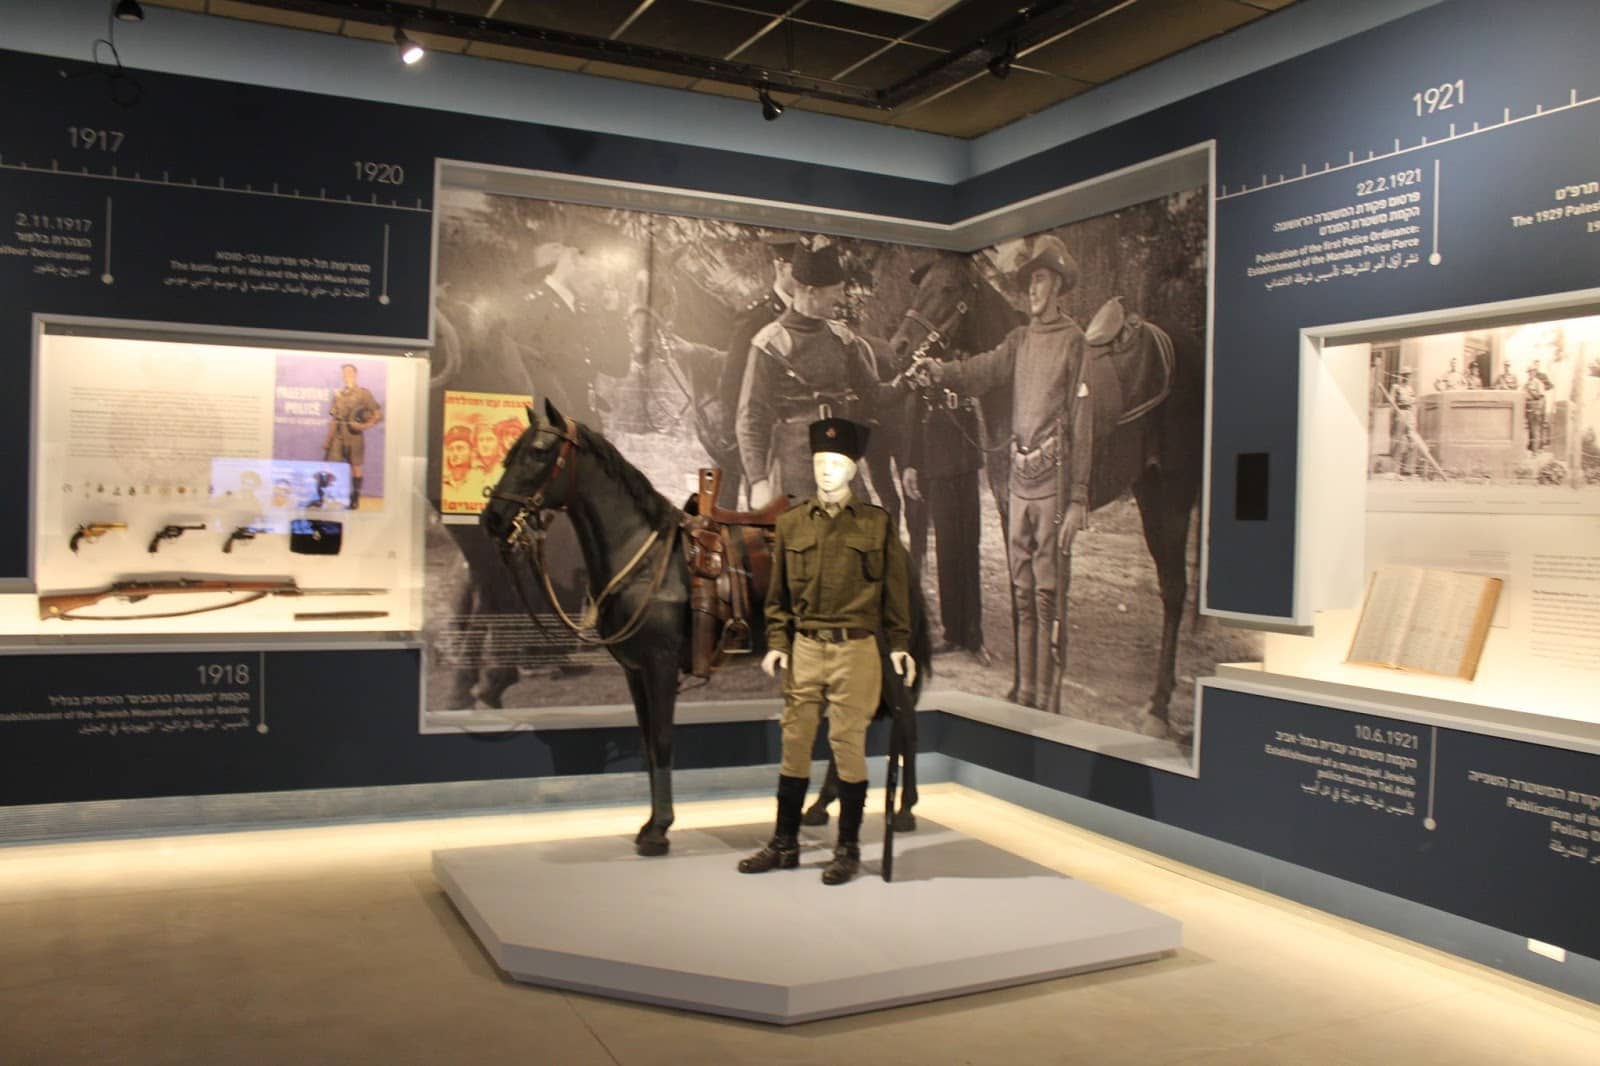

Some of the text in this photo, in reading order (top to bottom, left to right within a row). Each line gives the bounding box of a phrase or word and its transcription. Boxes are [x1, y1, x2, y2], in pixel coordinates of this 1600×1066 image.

[1413, 79, 1464, 117] 1921
[67, 126, 125, 152] 1917
[354, 161, 404, 184] 1920
[1356, 168, 1421, 196] 22.2.1921
[16, 212, 94, 232] 2.11.1917
[1511, 215, 1534, 228] The
[1535, 207, 1564, 224] 1929
[1255, 248, 1299, 265] Publication
[1299, 245, 1309, 256] of
[1309, 243, 1323, 254] the
[1323, 239, 1342, 251] first
[1342, 234, 1369, 248] Police
[1302, 256, 1311, 267] of
[1311, 254, 1325, 265] the
[1363, 242, 1392, 256] Police
[1392, 237, 1421, 251] Force
[198, 664, 249, 685] 1918
[1354, 724, 1419, 751] 10.6.1921
[1506, 795, 1571, 820] Publication
[1572, 811, 1587, 825] of
[1551, 819, 1589, 840] Police
